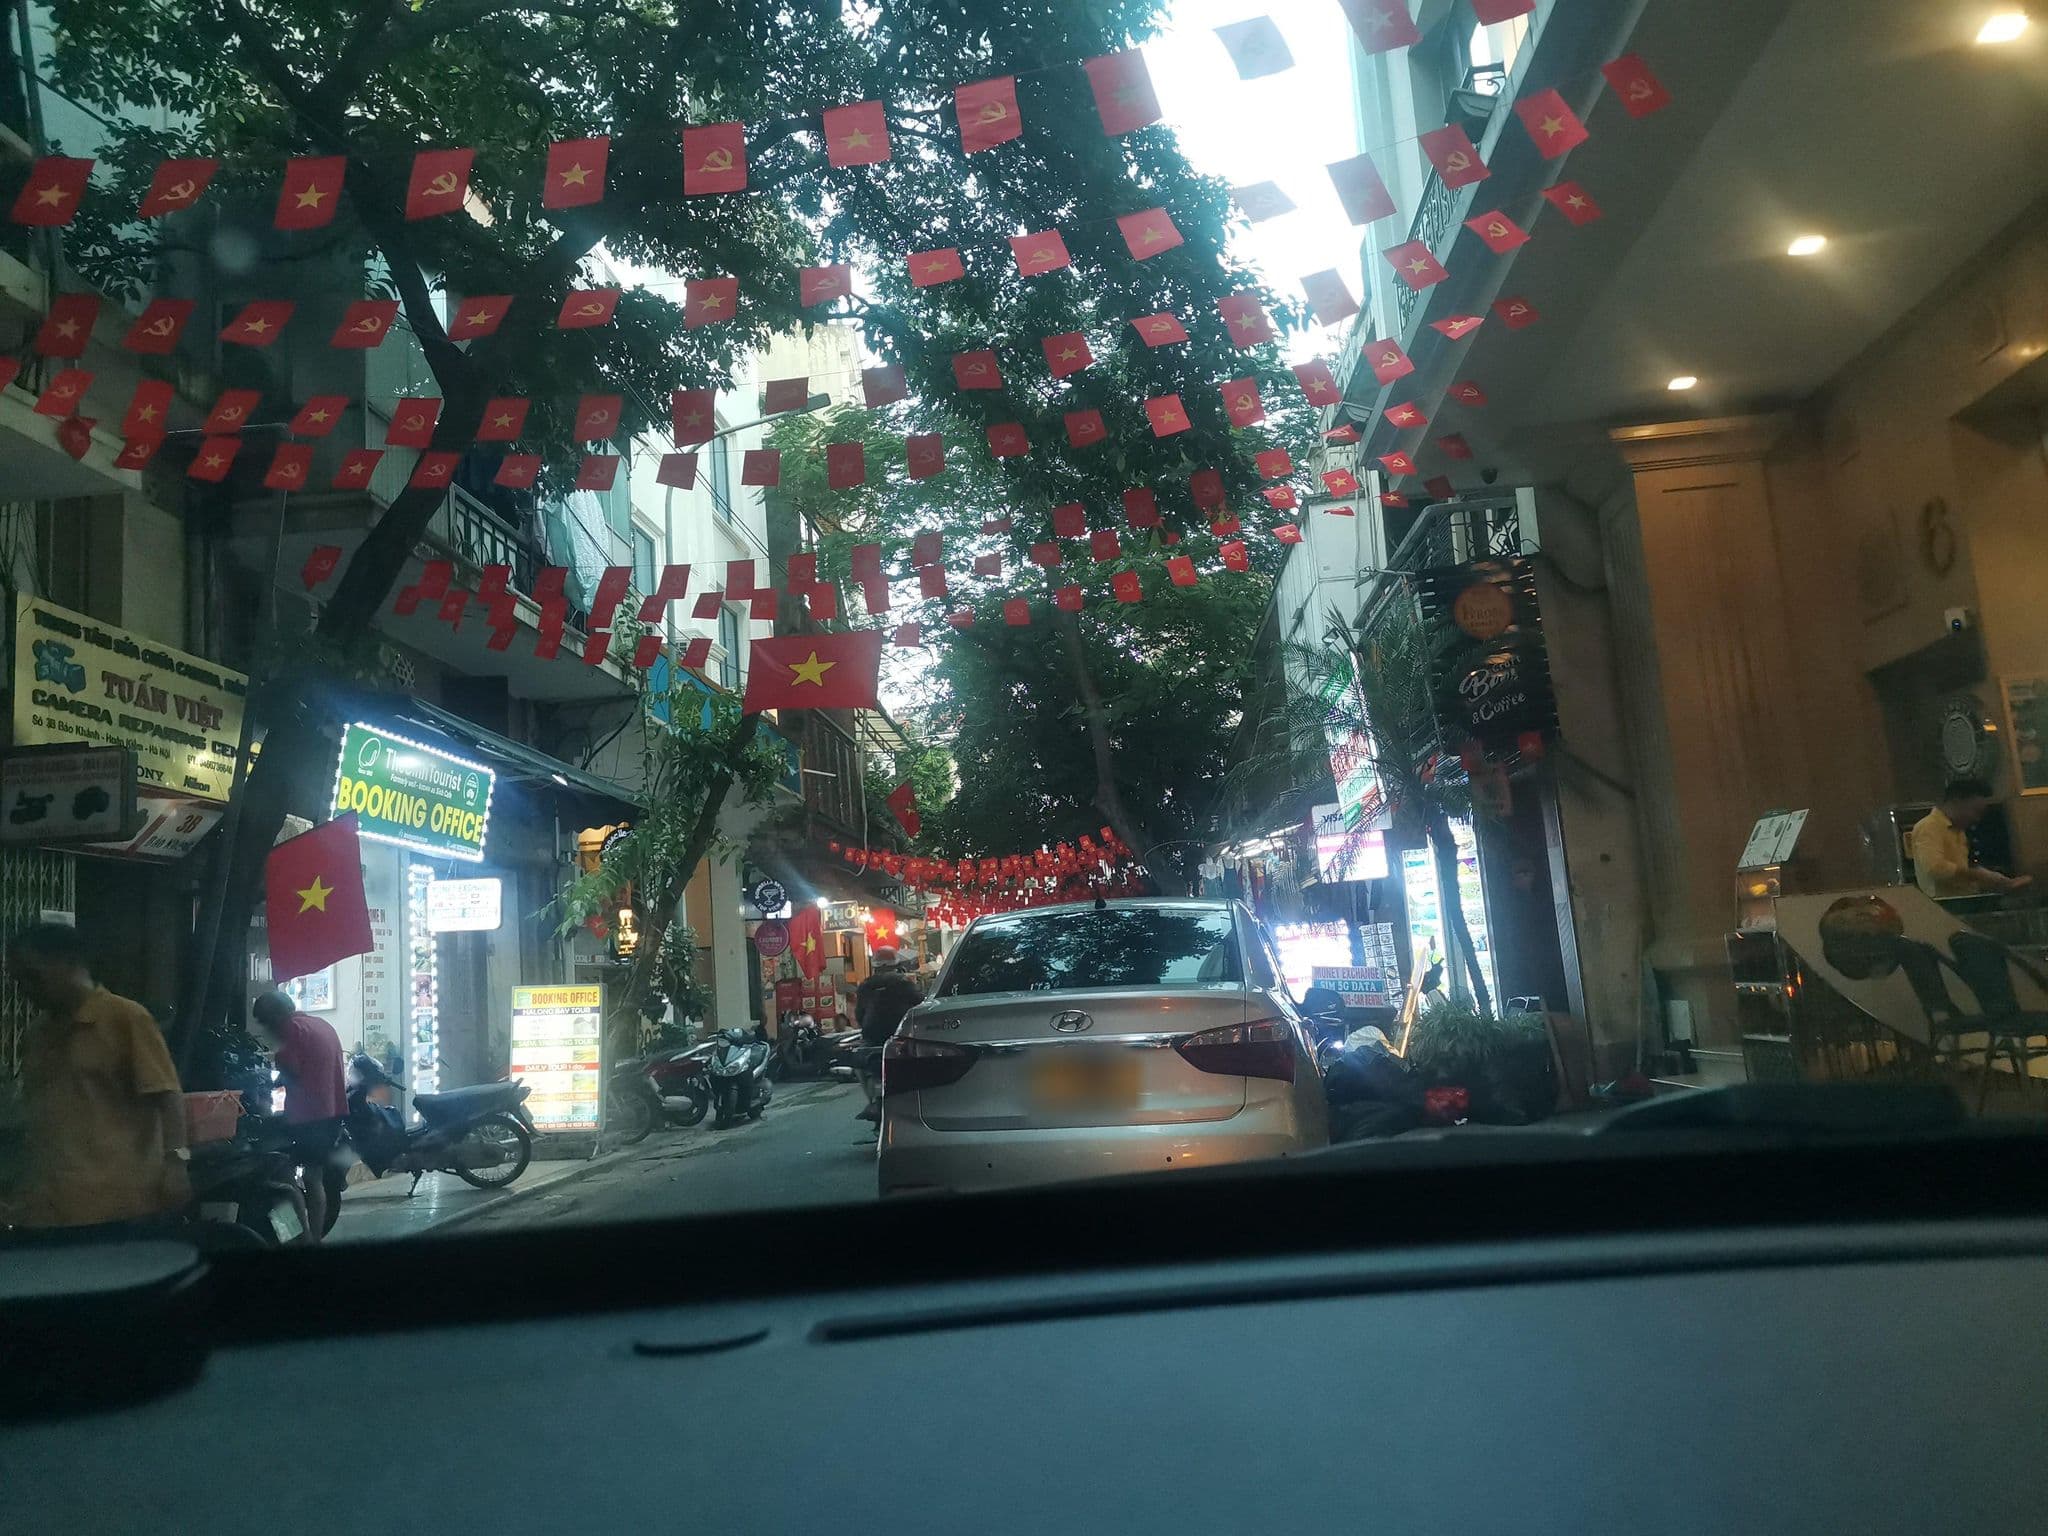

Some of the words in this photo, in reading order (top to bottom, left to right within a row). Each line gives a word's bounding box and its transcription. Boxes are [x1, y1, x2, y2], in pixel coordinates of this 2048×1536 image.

[31, 688, 113, 726] CAMERA
[101, 672, 169, 716] TUẤN
[173, 695, 223, 734] VIỆT
[1479, 692, 1528, 721] Coffee
[135, 766, 165, 782] ONY
[183, 775, 211, 793] Nikon
[337, 775, 427, 830] BOOKING
[430, 802, 484, 843] OFFICE
[176, 815, 204, 834] 3B
[1322, 813, 1344, 824] VISA
[1316, 967, 1340, 980] MONEY
[1342, 966, 1380, 980] EXCHANGE
[1320, 981, 1336, 992] SIM
[1338, 981, 1350, 992] 5G
[1351, 981, 1377, 992] DATA
[532, 992, 568, 1004] BOOKING
[570, 991, 598, 1004] OFFICE
[522, 1008, 553, 1016] HALONG
[554, 1007, 570, 1015] BAY
[571, 1006, 591, 1014] TOUR
[525, 1064, 547, 1072] DAILY
[548, 1063, 568, 1072] TOUR
